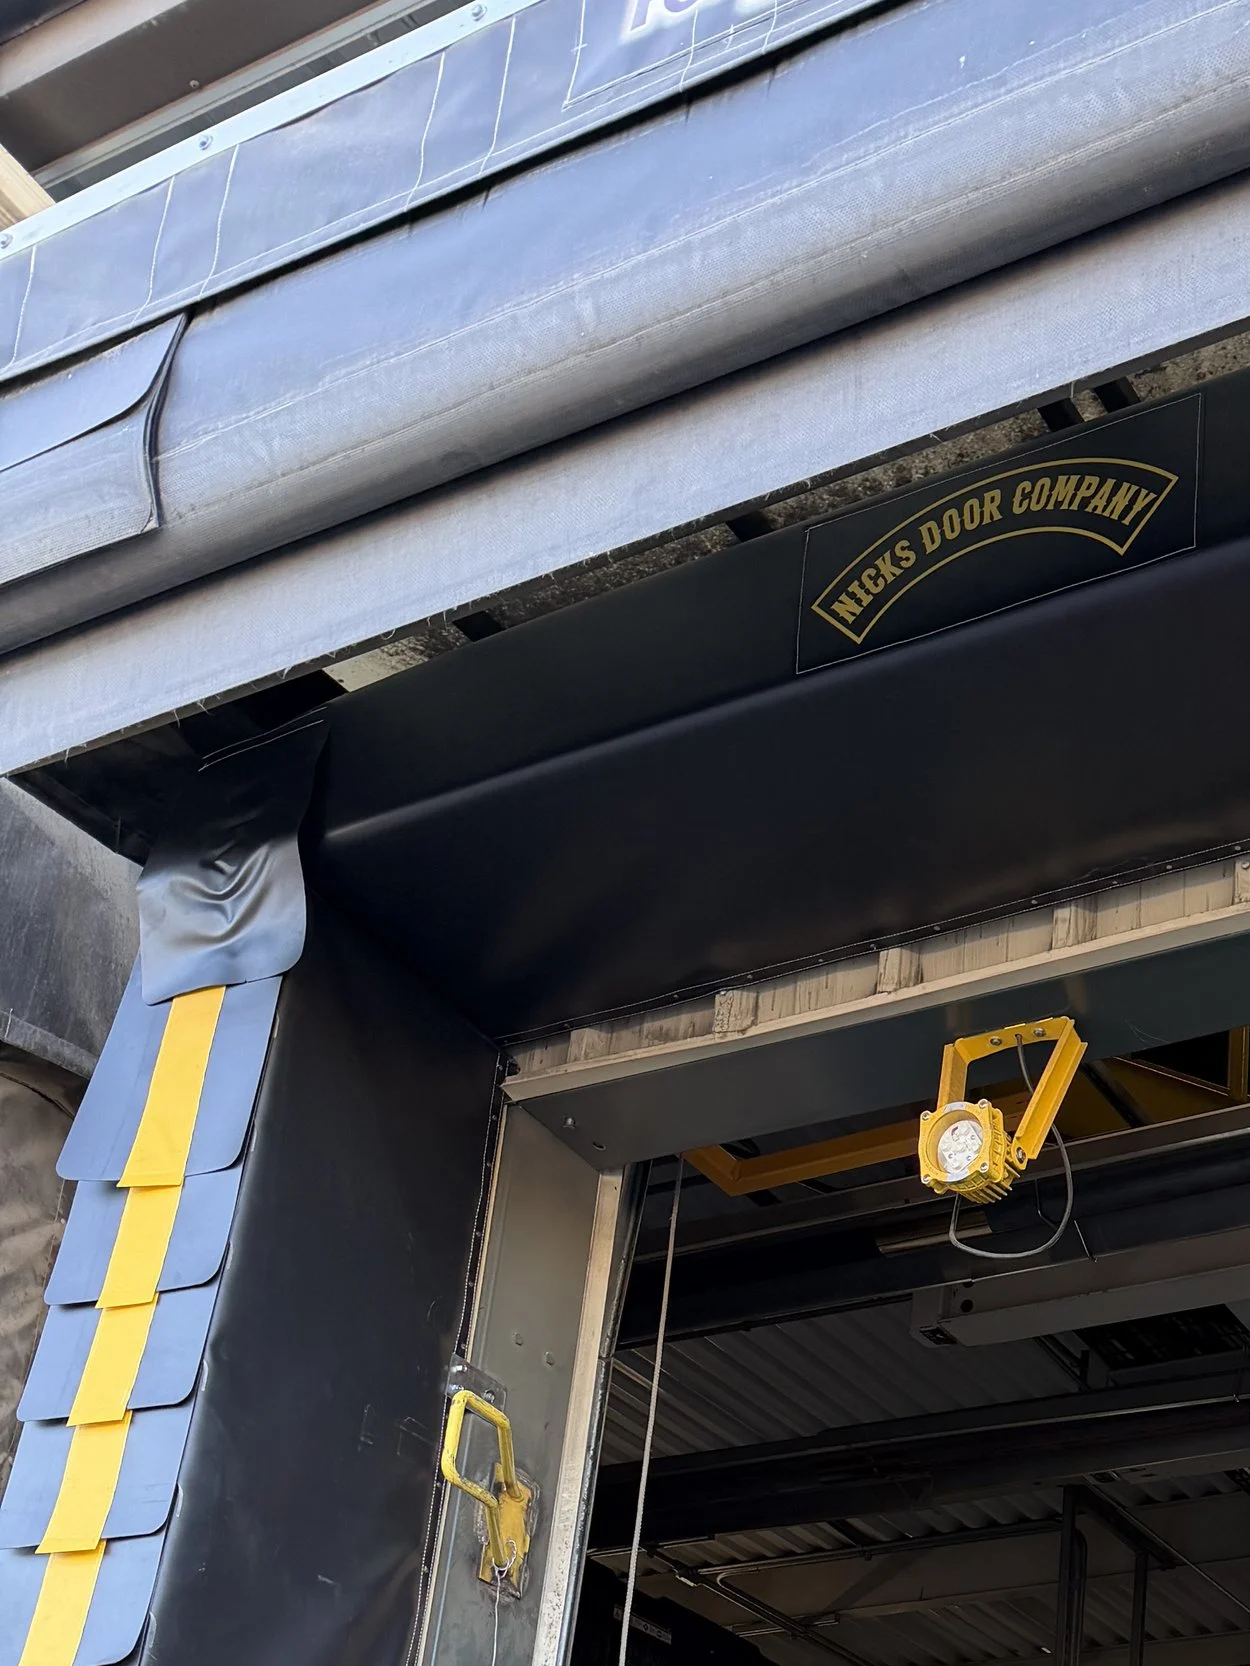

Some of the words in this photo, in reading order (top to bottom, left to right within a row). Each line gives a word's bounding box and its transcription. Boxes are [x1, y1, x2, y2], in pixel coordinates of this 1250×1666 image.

[830, 539, 917, 624] NICKS
[918, 488, 1003, 554] DOOR
[1012, 474, 1157, 526] COMPANY
